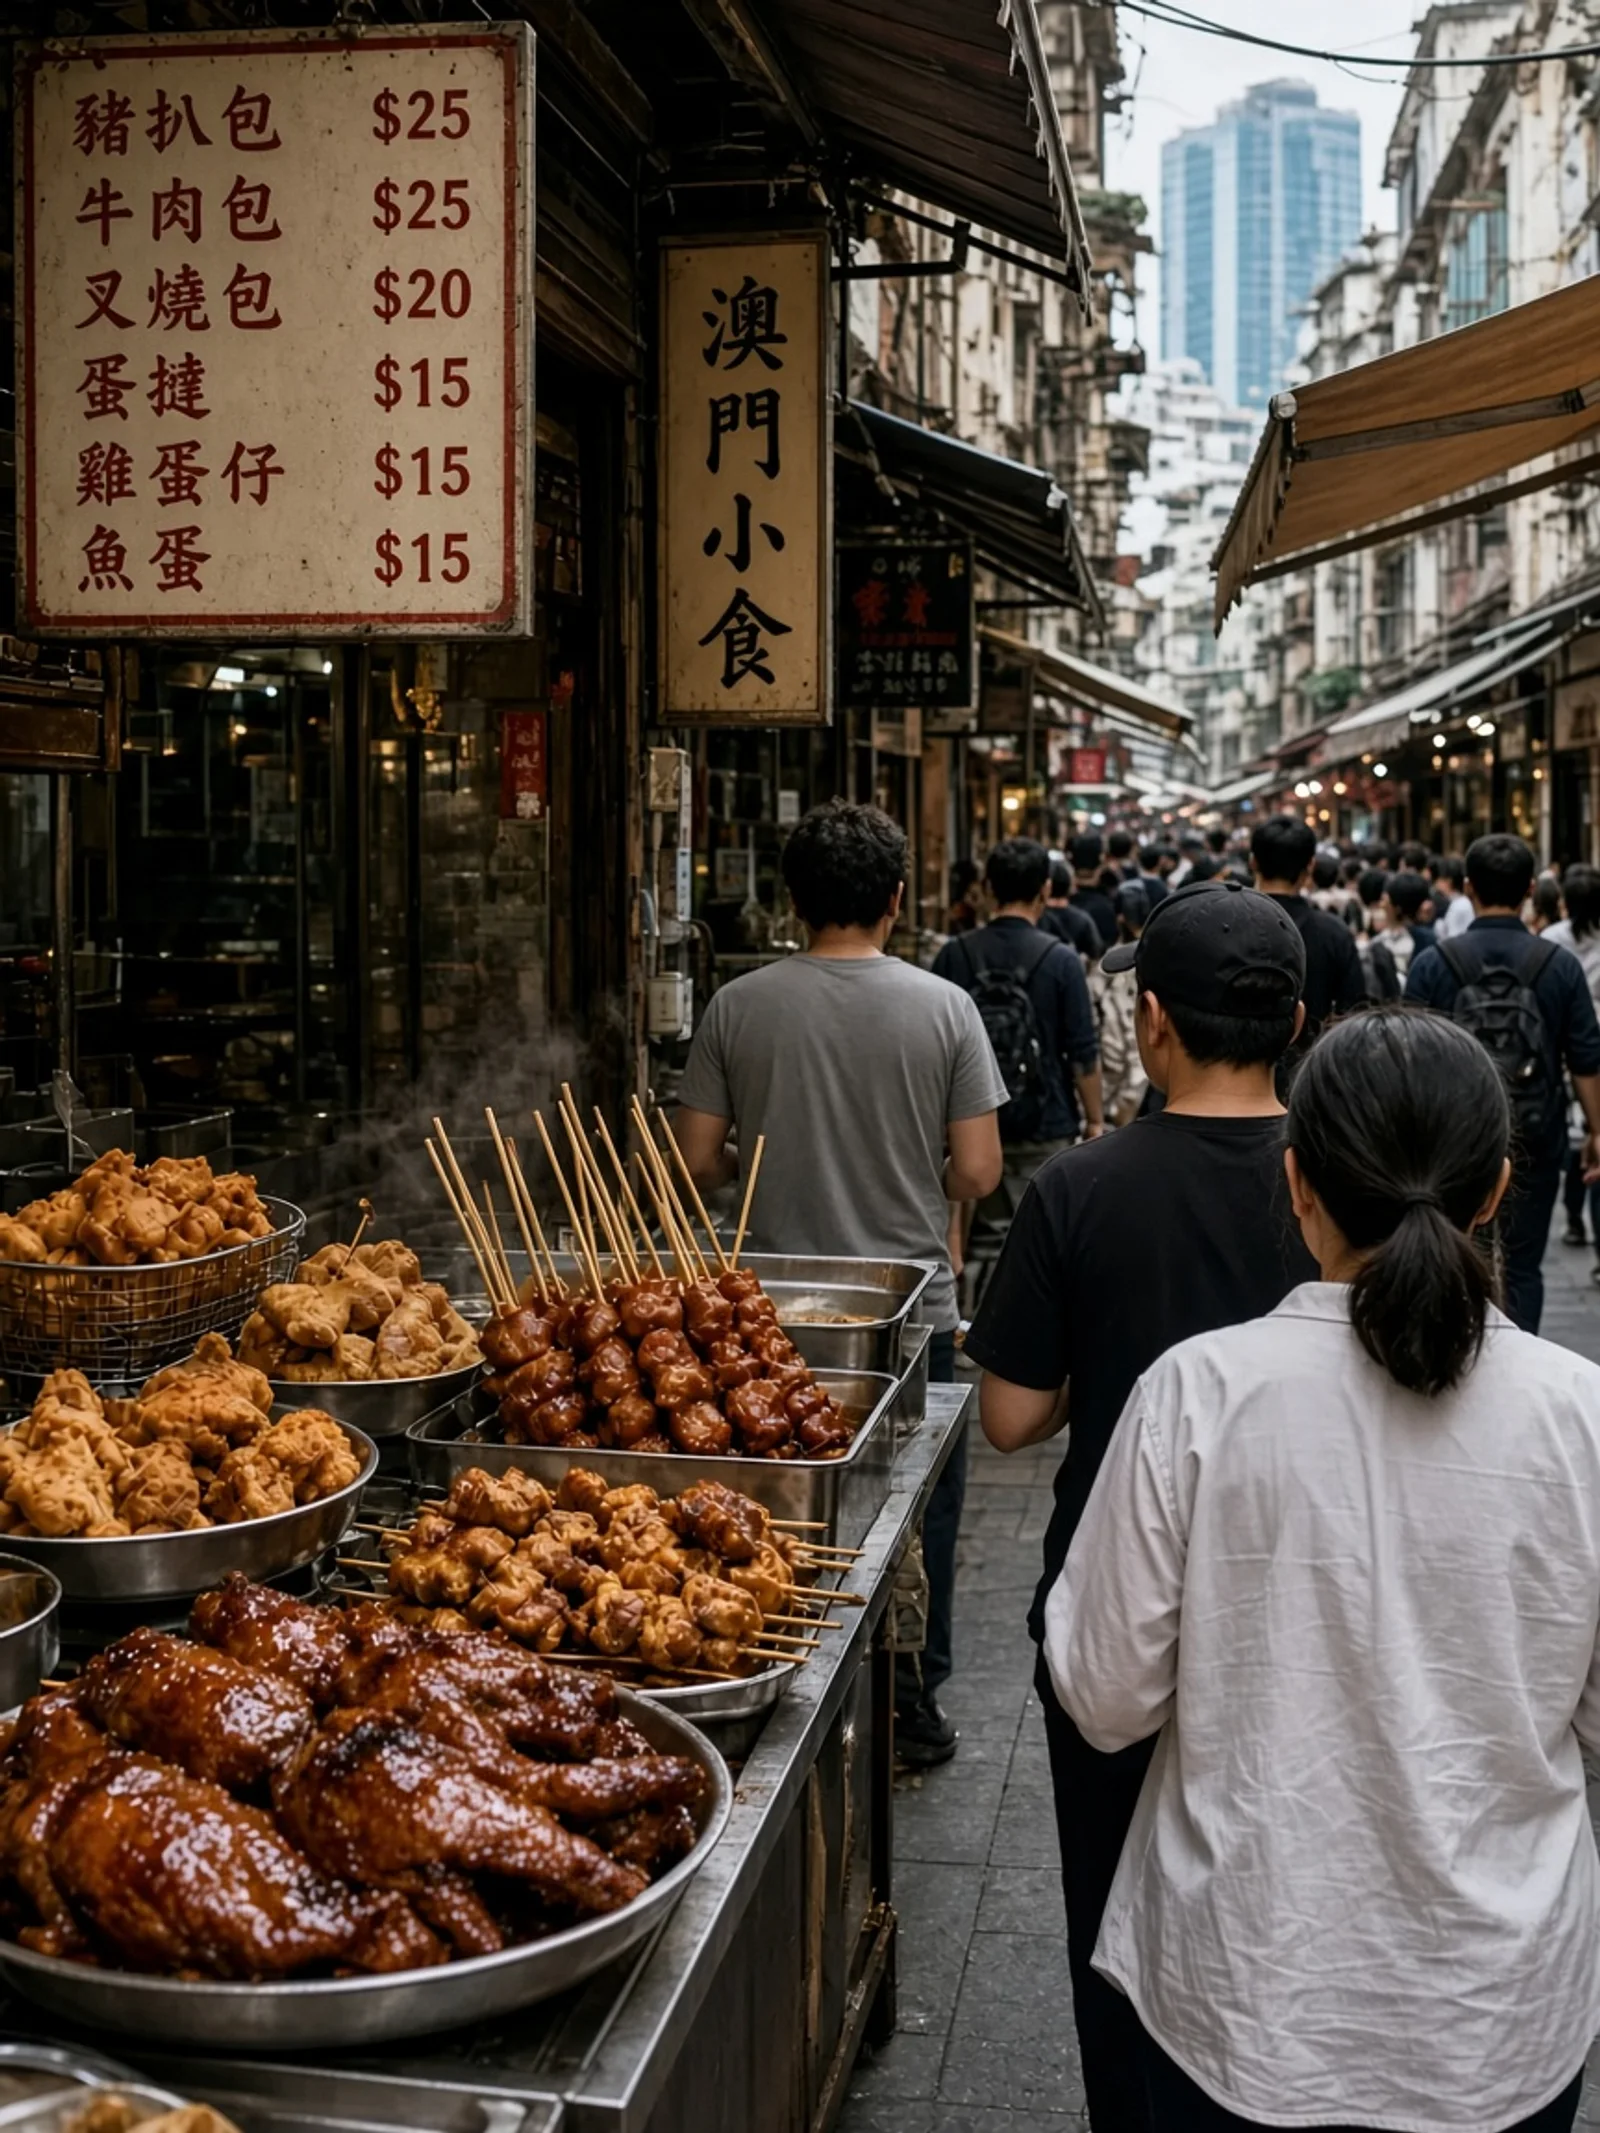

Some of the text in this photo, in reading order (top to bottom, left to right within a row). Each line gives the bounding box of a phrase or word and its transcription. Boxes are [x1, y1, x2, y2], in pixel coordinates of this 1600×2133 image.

[72, 84, 470, 156] 豬扒包 $25
[75, 174, 471, 246] 牛肉包 $25
[74, 262, 472, 332] 叉燒包 $20
[75, 351, 470, 421] 蛋撻 $15
[75, 439, 470, 507] 雞蛋仔 $15
[698, 275, 793, 690] 澳門小食
[77, 523, 470, 593] 魚蛋 $15
